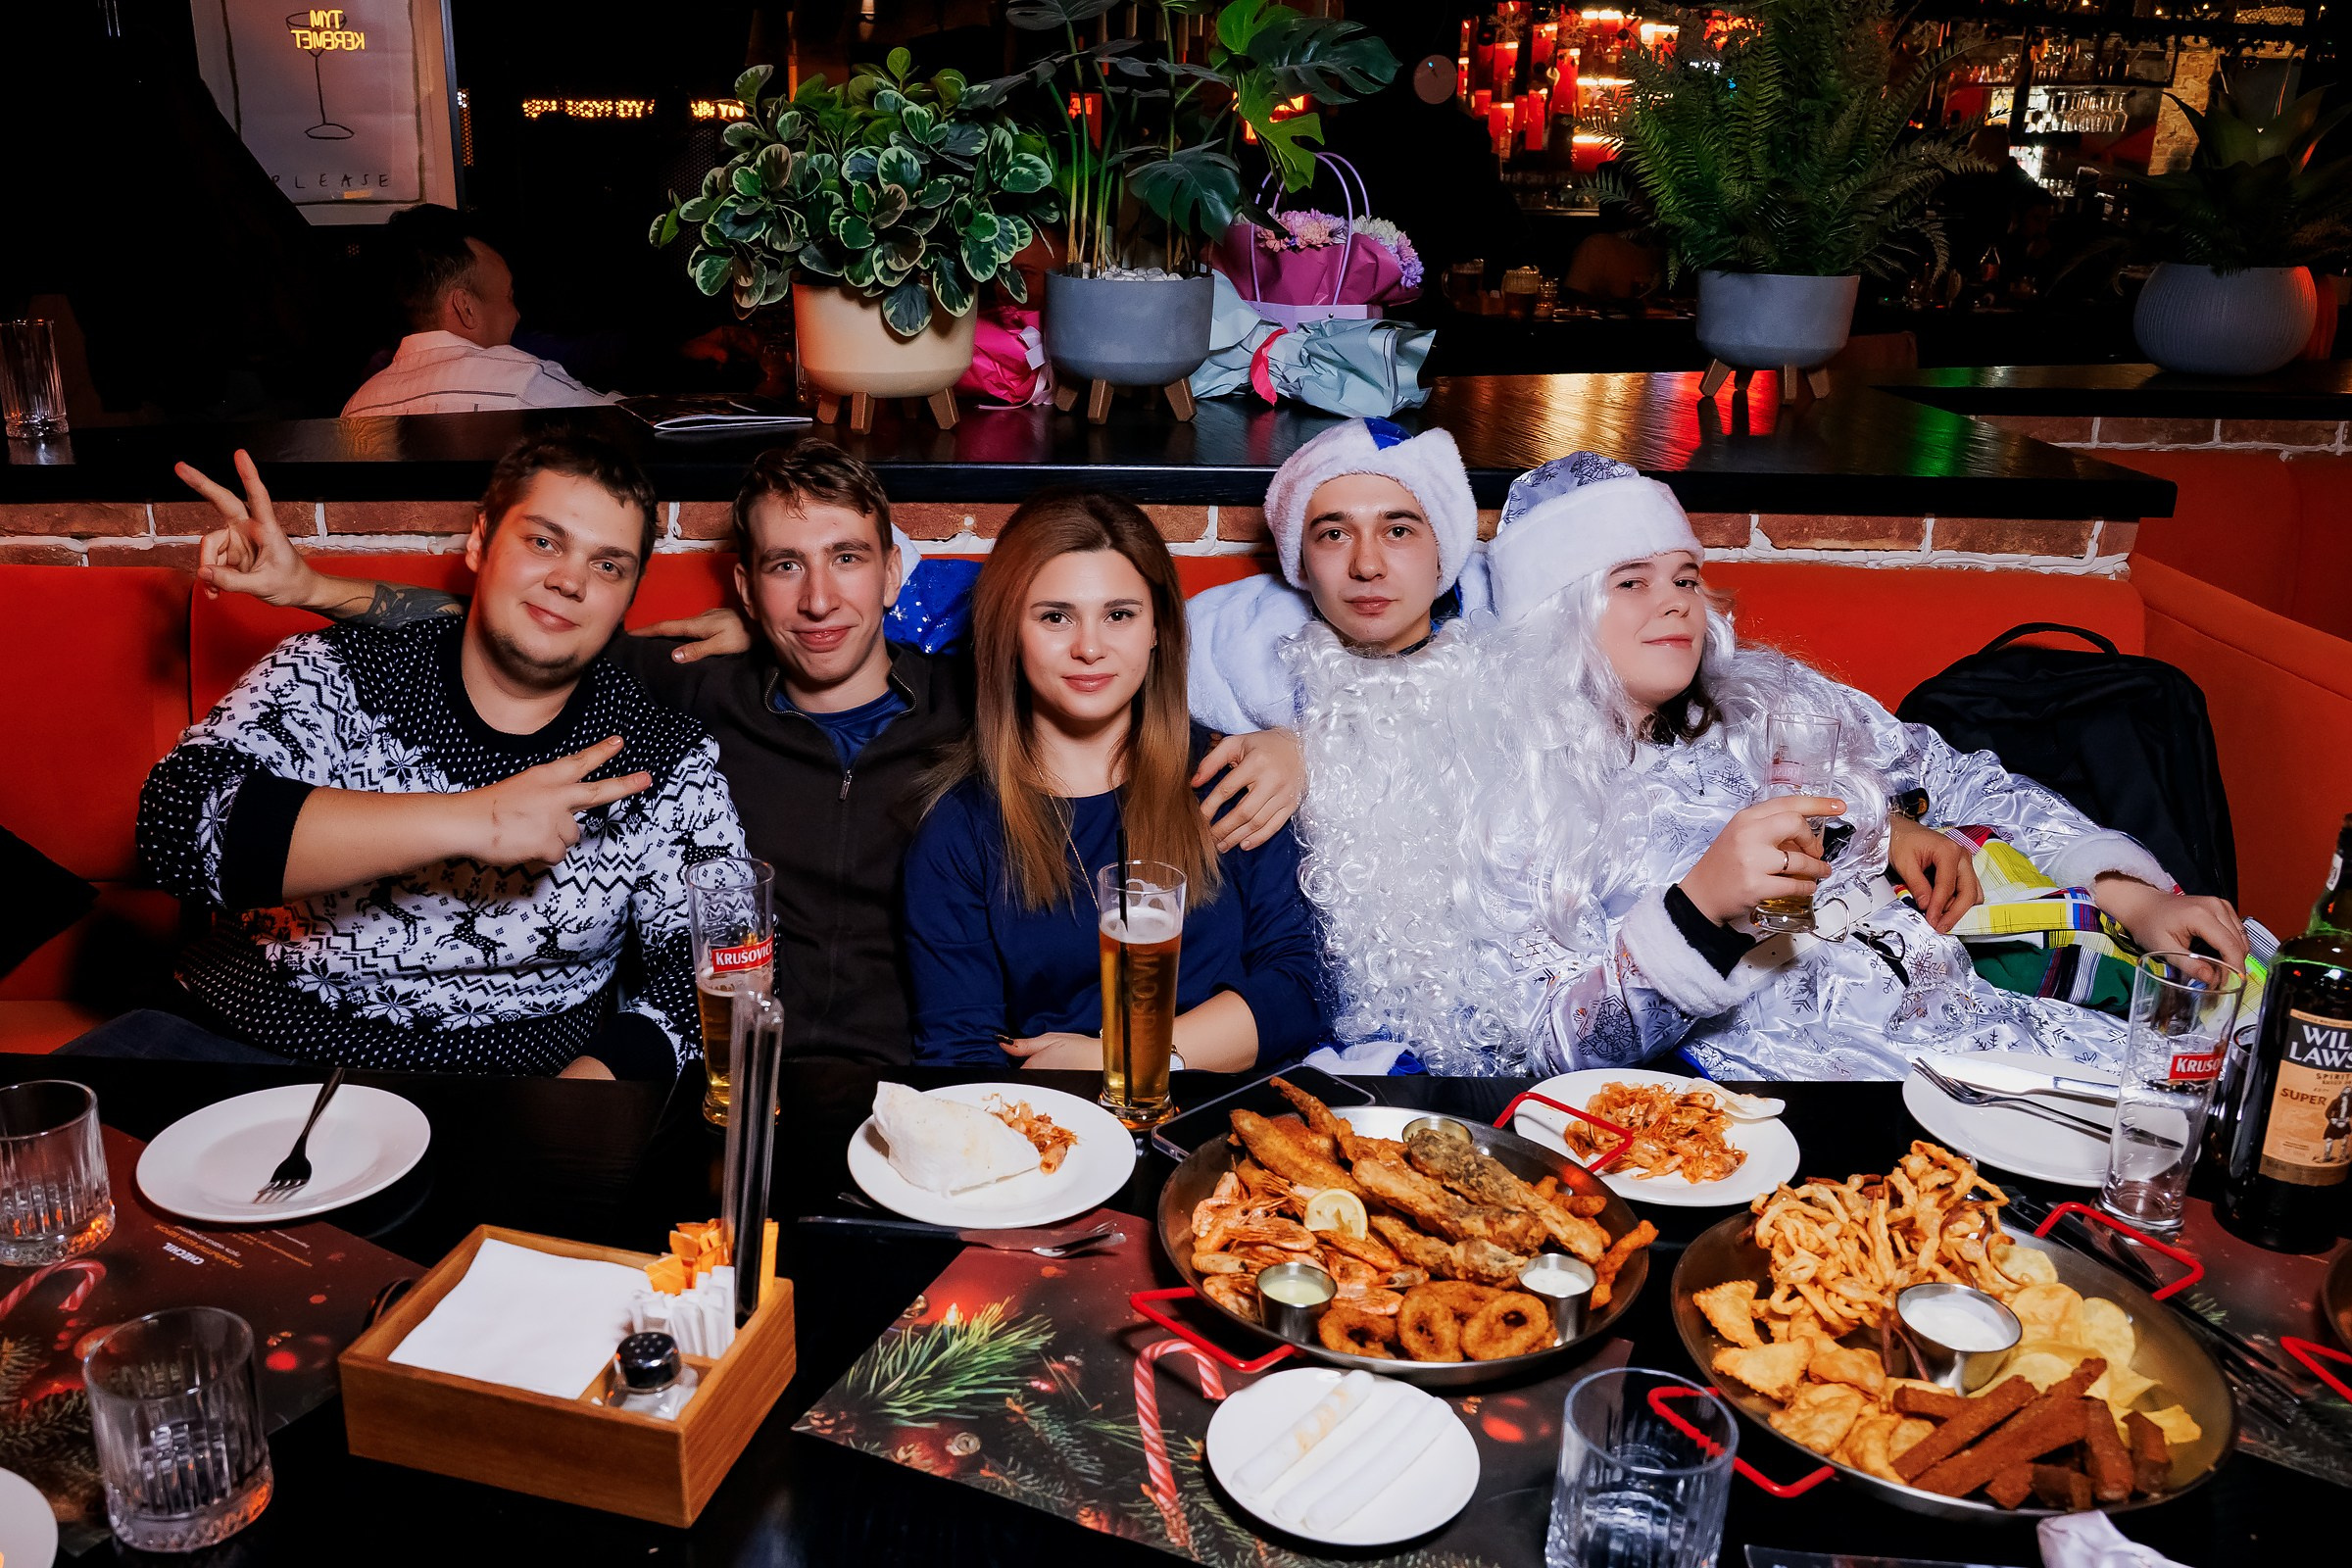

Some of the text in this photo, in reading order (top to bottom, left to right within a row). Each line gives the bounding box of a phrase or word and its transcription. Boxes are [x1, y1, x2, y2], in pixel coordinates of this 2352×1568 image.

[271, 173, 389, 188] PLEASE
[2302, 1024, 2352, 1051] WIL
[2279, 1088, 2328, 1105] SUPER
[163, 1242, 204, 1264] CHECHIL
